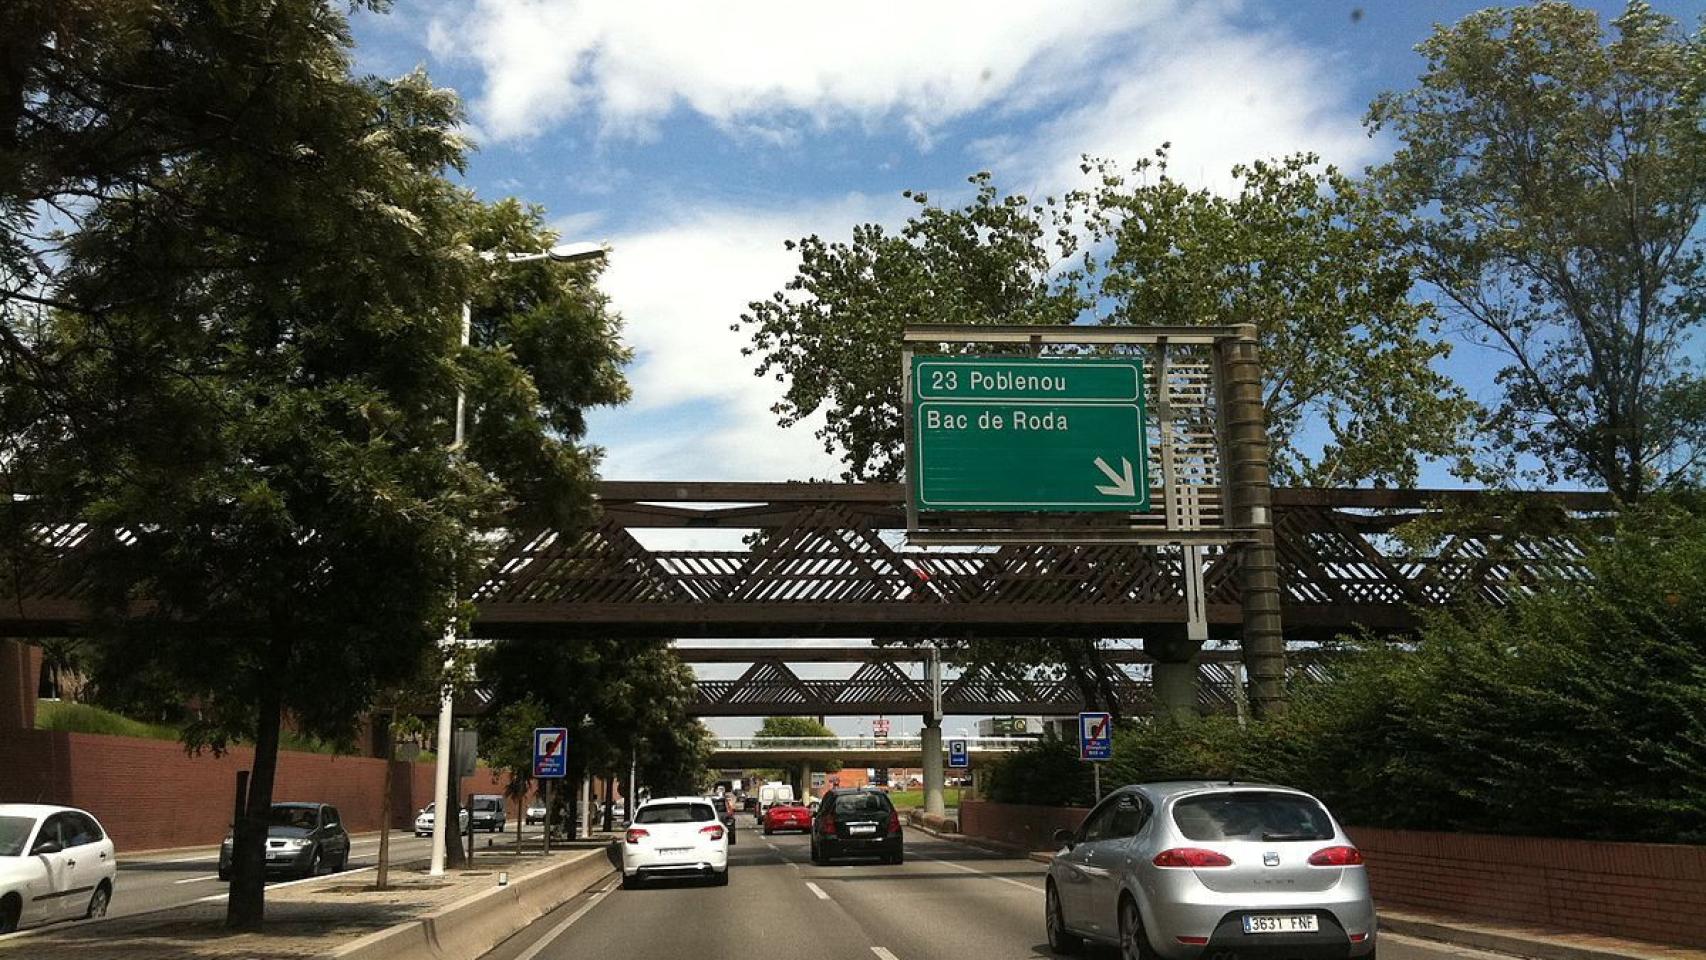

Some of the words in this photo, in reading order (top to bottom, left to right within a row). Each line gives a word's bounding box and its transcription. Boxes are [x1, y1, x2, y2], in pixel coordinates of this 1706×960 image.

[932, 371, 958, 390] 23
[970, 371, 1066, 391] Poblenou
[927, 410, 968, 430] Bac
[978, 411, 1003, 430] de
[1013, 411, 1069, 431] Roda
[1252, 917, 1282, 931] 3631
